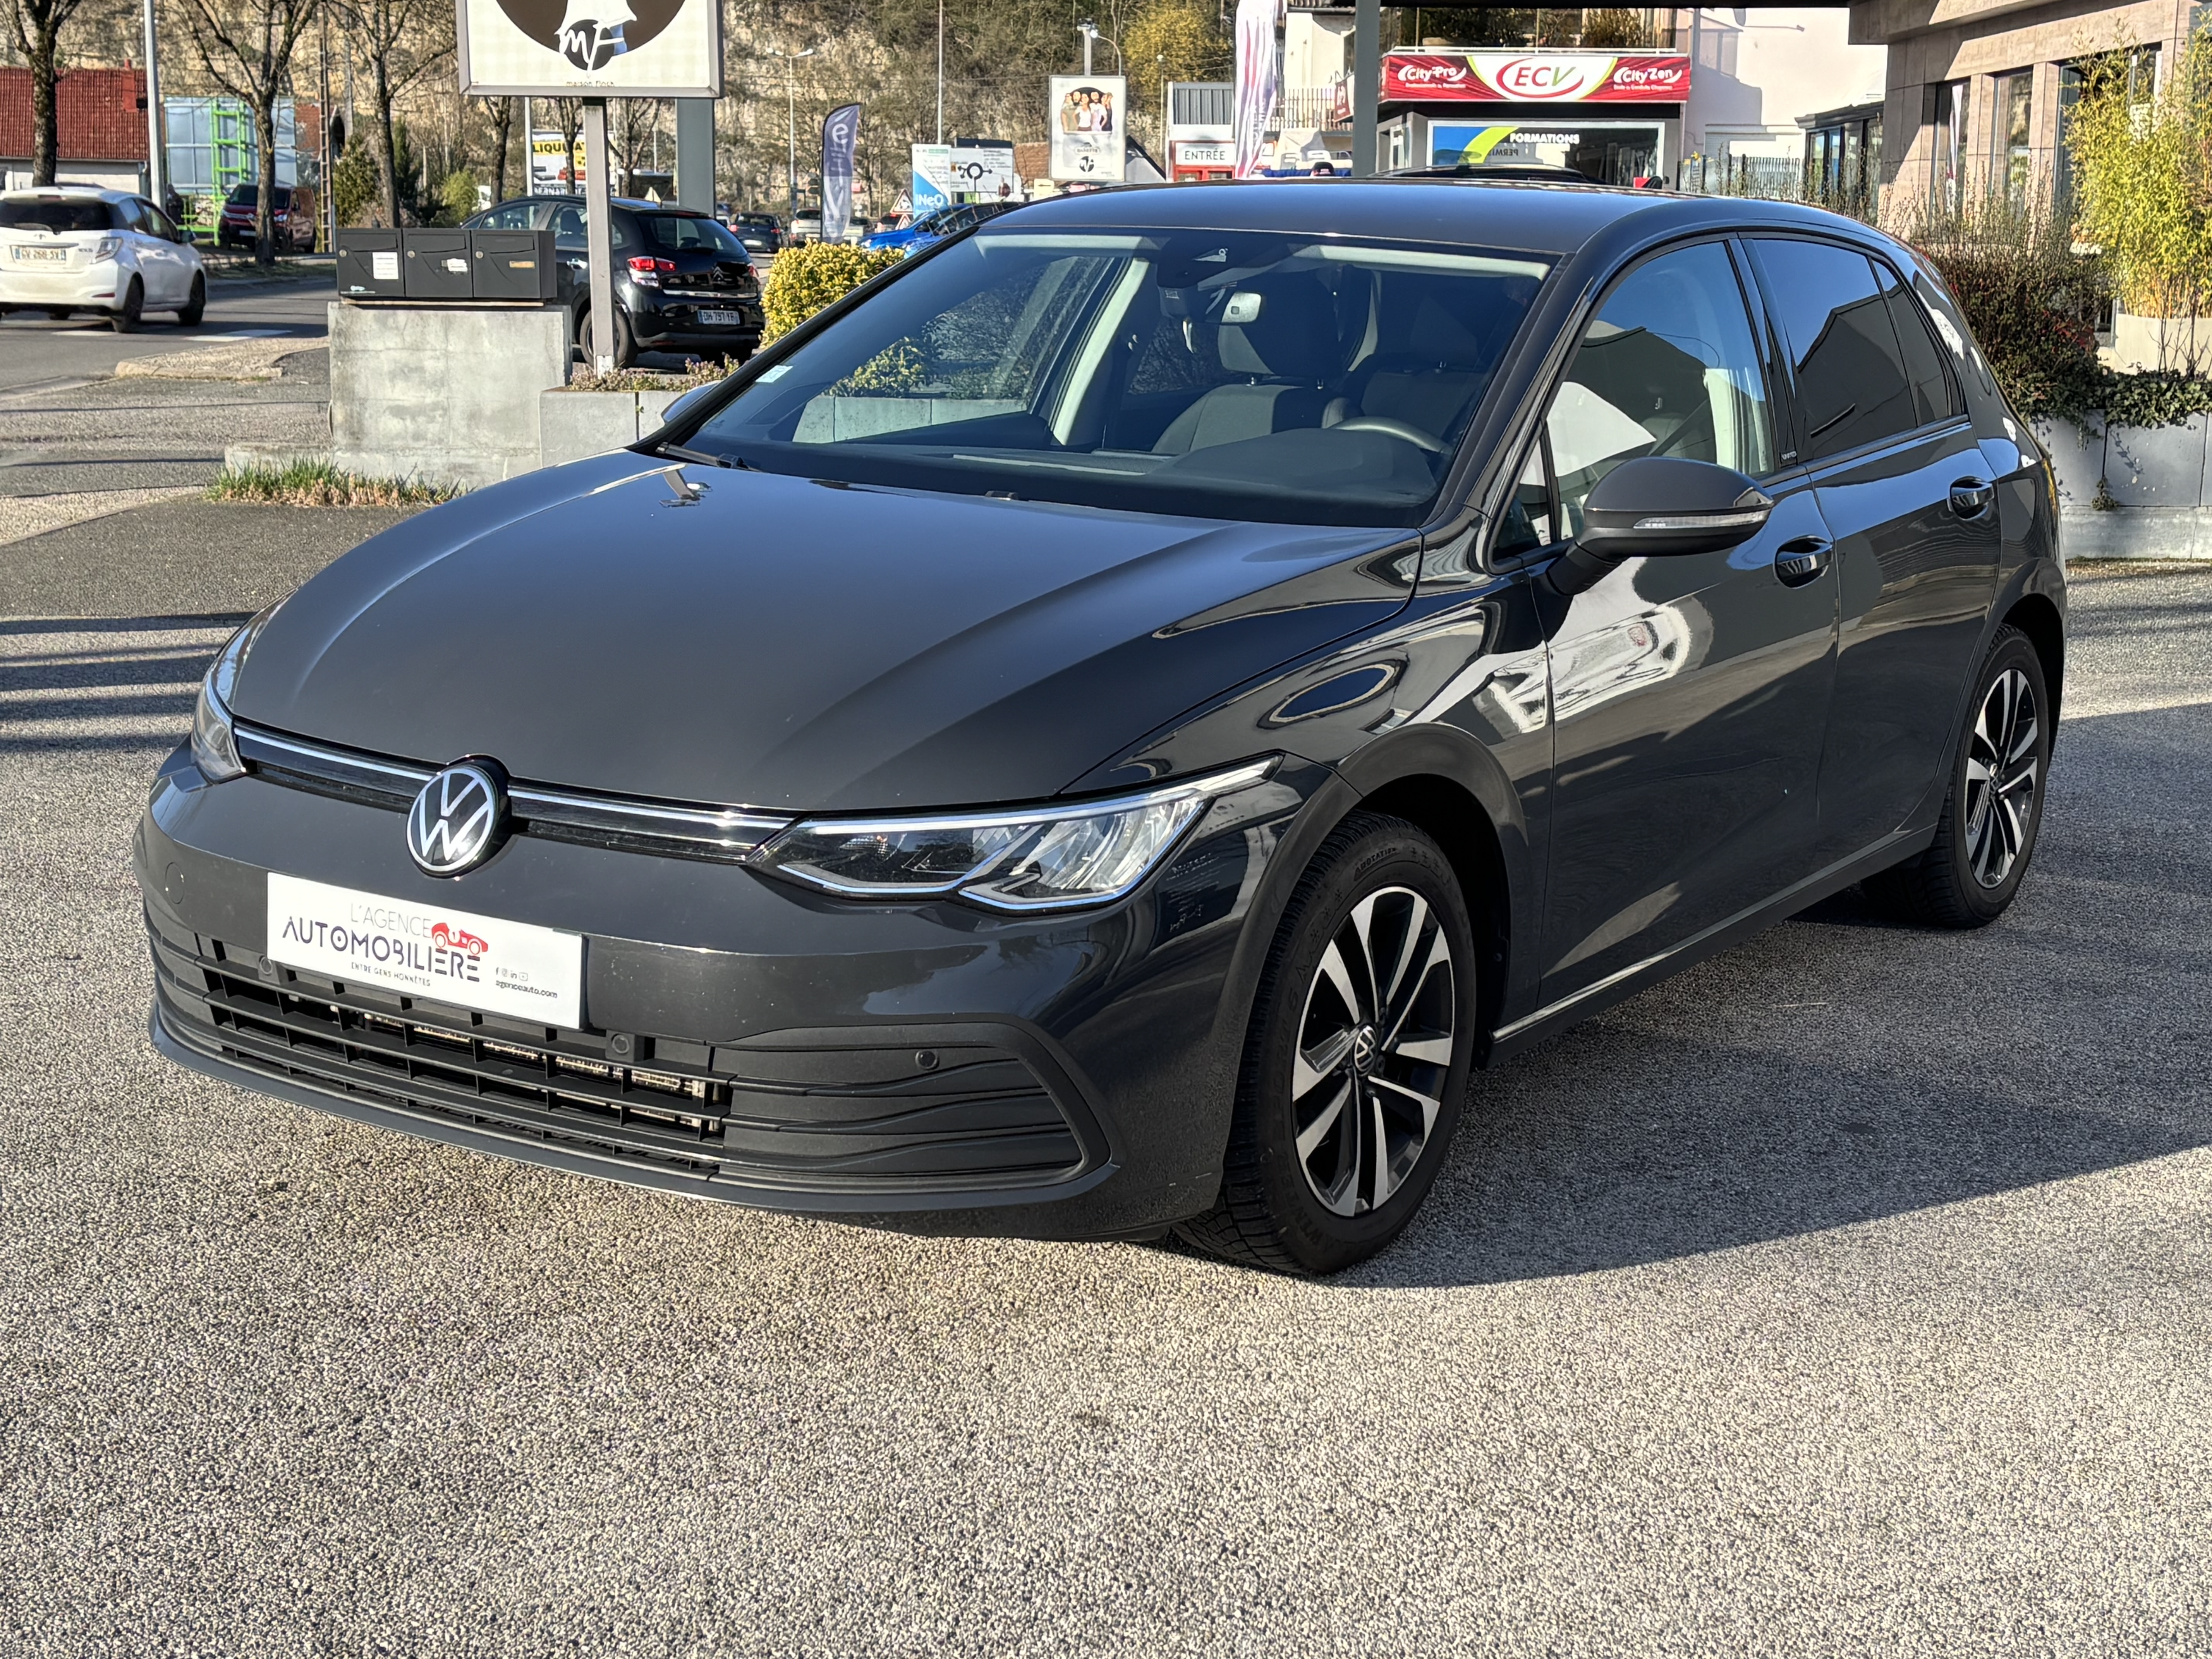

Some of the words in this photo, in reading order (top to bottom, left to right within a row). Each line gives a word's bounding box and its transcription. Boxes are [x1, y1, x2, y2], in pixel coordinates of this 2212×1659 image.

[1514, 67, 1576, 86] ECV
[1510, 133, 1580, 144] FORMATIONS
[1185, 148, 1225, 160] ENTRÉE
[351, 903, 431, 938] L'AGENCE
[351, 962, 371, 973] ENTRE
[374, 967, 392, 977] GENS
[394, 973, 431, 987] HONNÊTES
[496, 980, 558, 998] agenceauto.com
